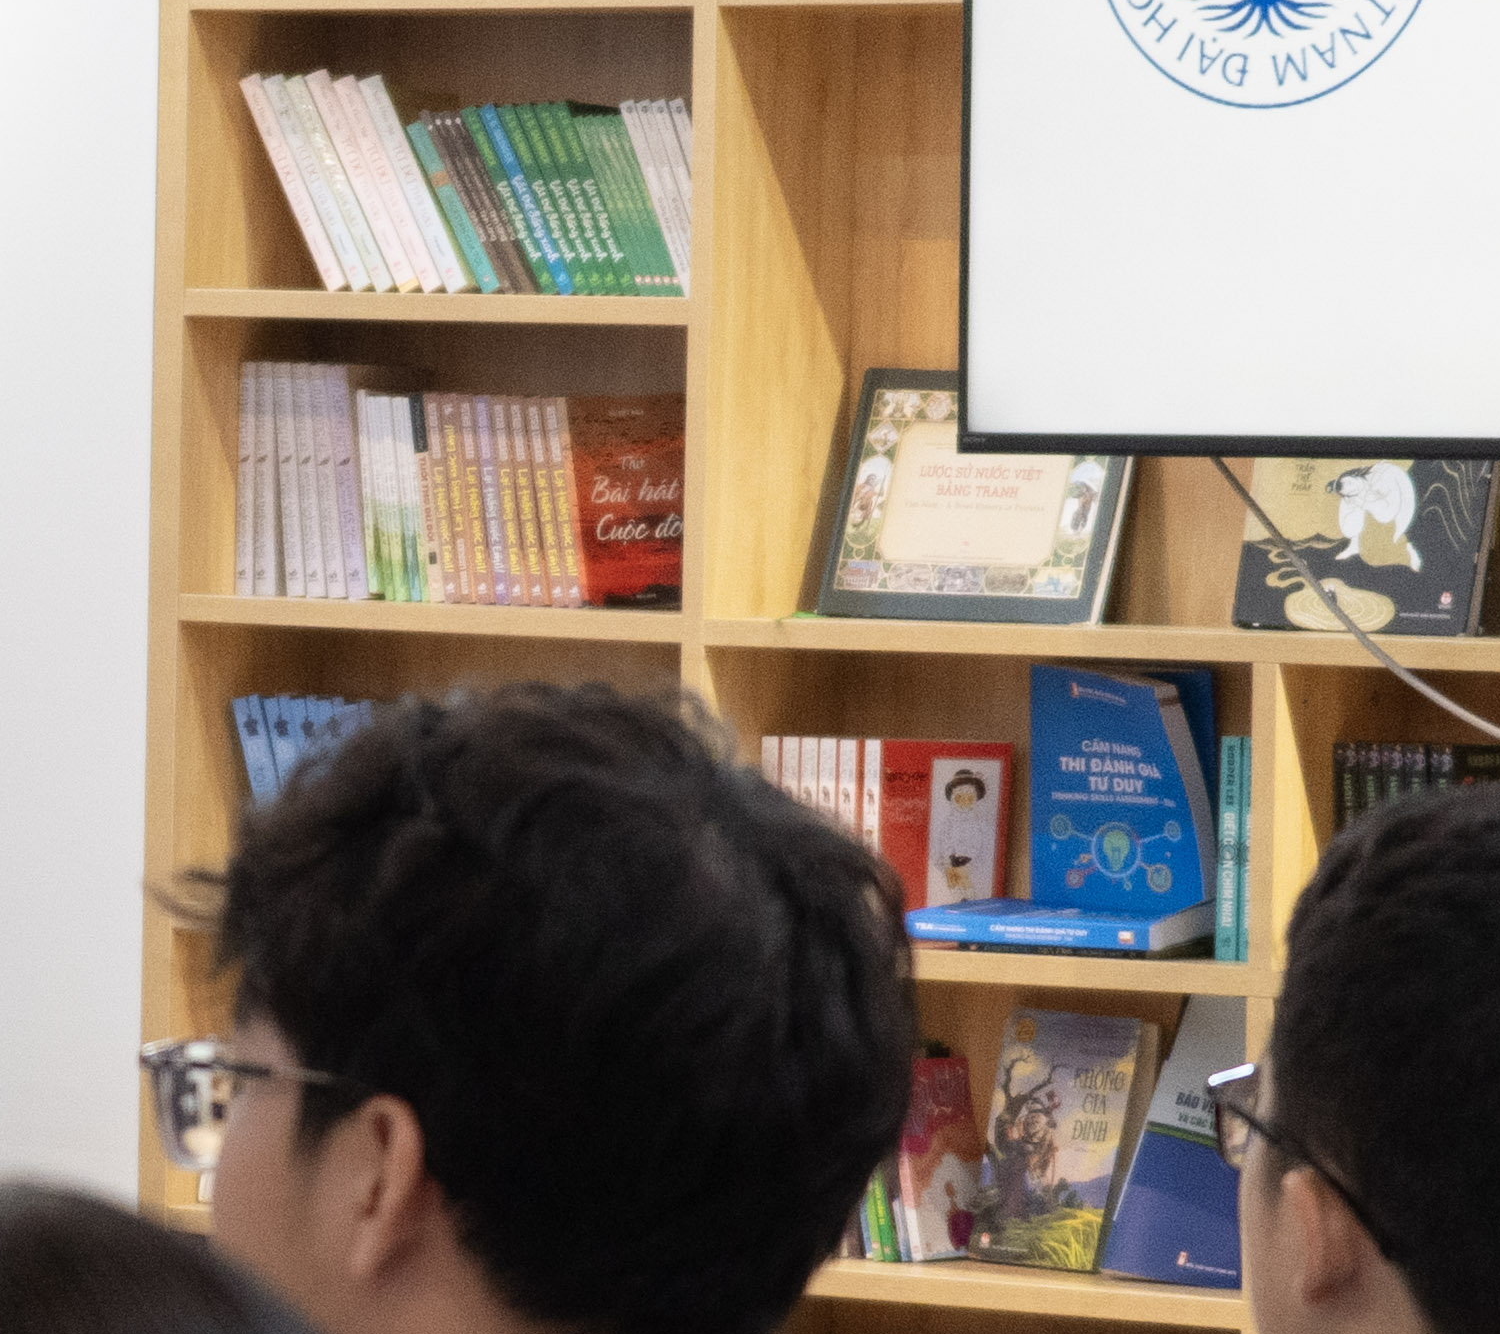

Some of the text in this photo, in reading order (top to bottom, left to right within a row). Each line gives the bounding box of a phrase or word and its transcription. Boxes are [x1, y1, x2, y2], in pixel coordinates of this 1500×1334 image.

[590, 475, 632, 505] Bài
[637, 477, 680, 502] hát
[595, 513, 649, 546] Cuộc
[1058, 756, 1086, 773] THI
[1090, 755, 1135, 775] ĐÁNH
[1112, 777, 1144, 794] DUY
